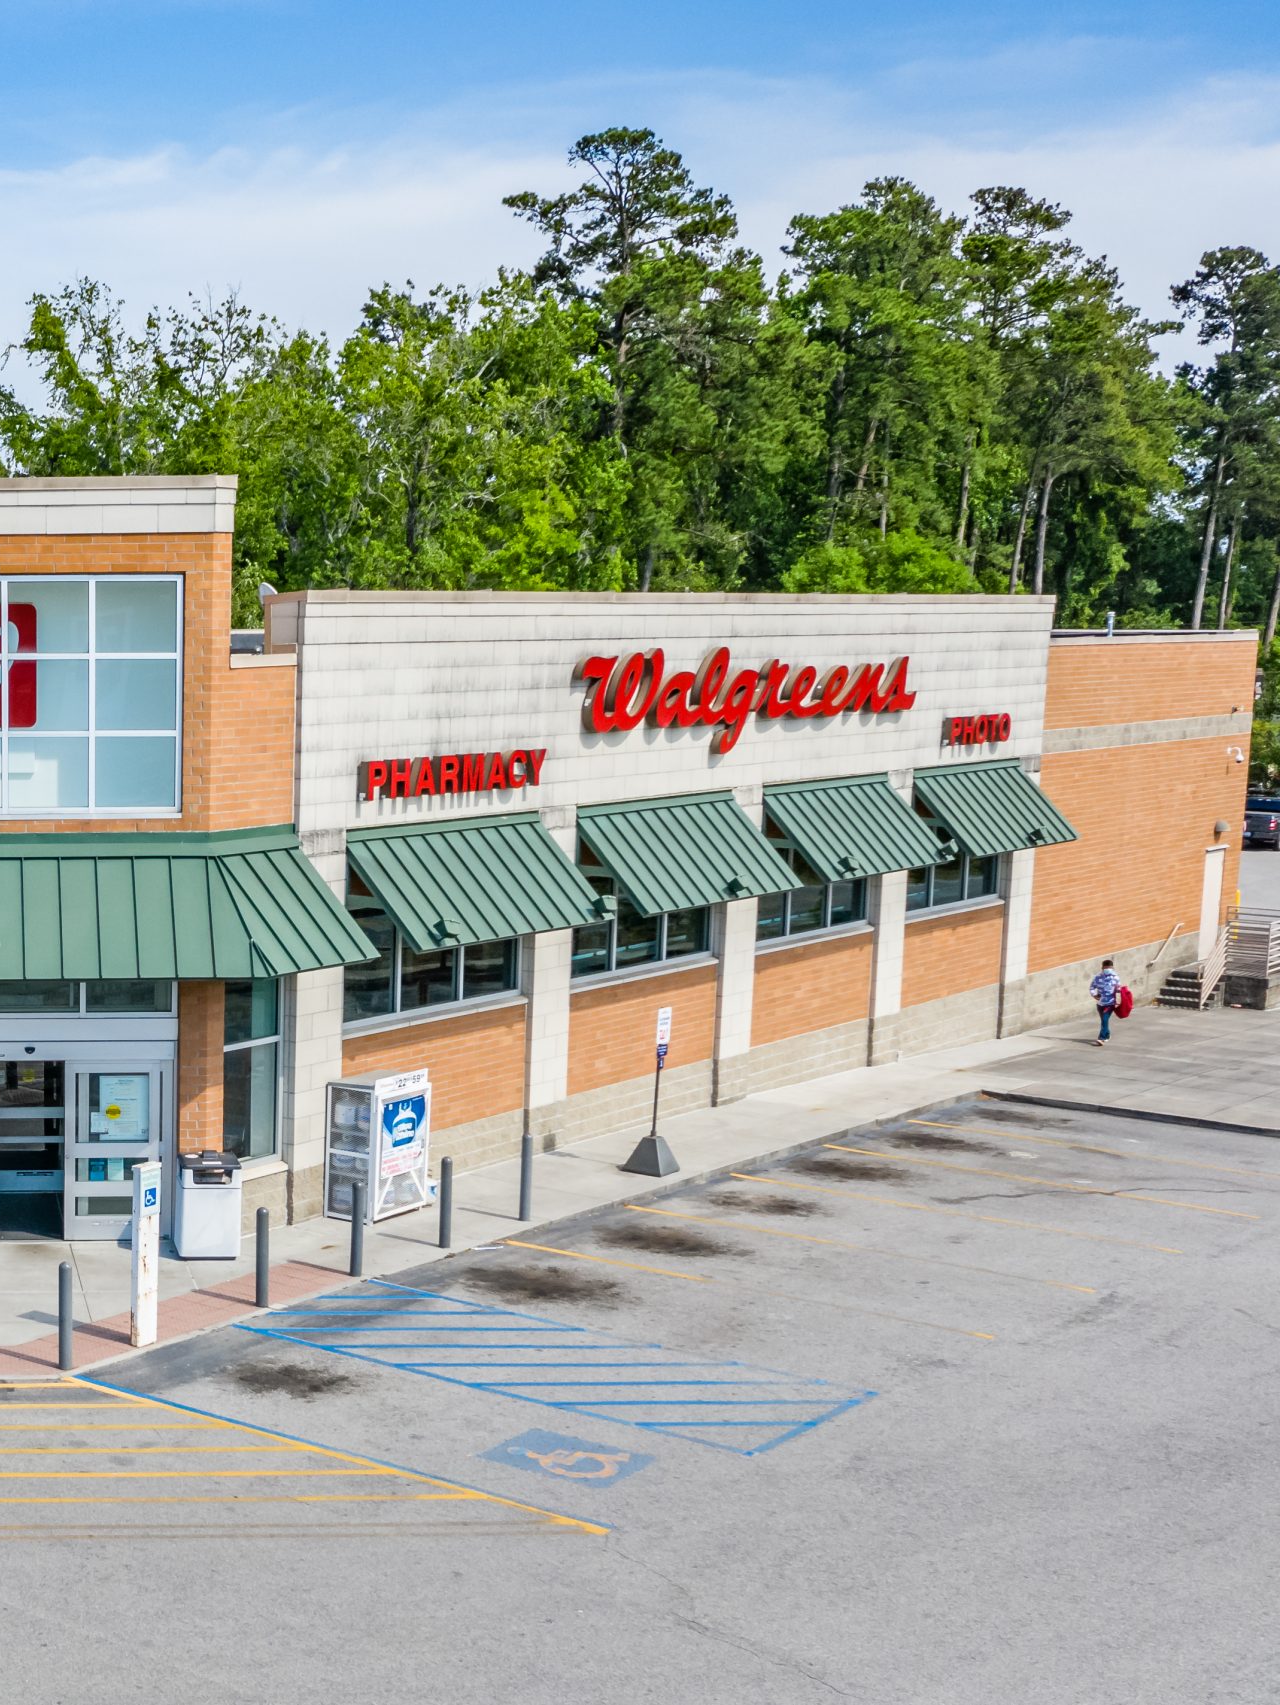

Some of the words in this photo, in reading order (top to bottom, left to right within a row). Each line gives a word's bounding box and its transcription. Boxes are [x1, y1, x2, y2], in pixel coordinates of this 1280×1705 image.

[575, 646, 917, 755] Walgreens
[948, 712, 1011, 747] PHOTO
[365, 748, 548, 802] PHARMACY
